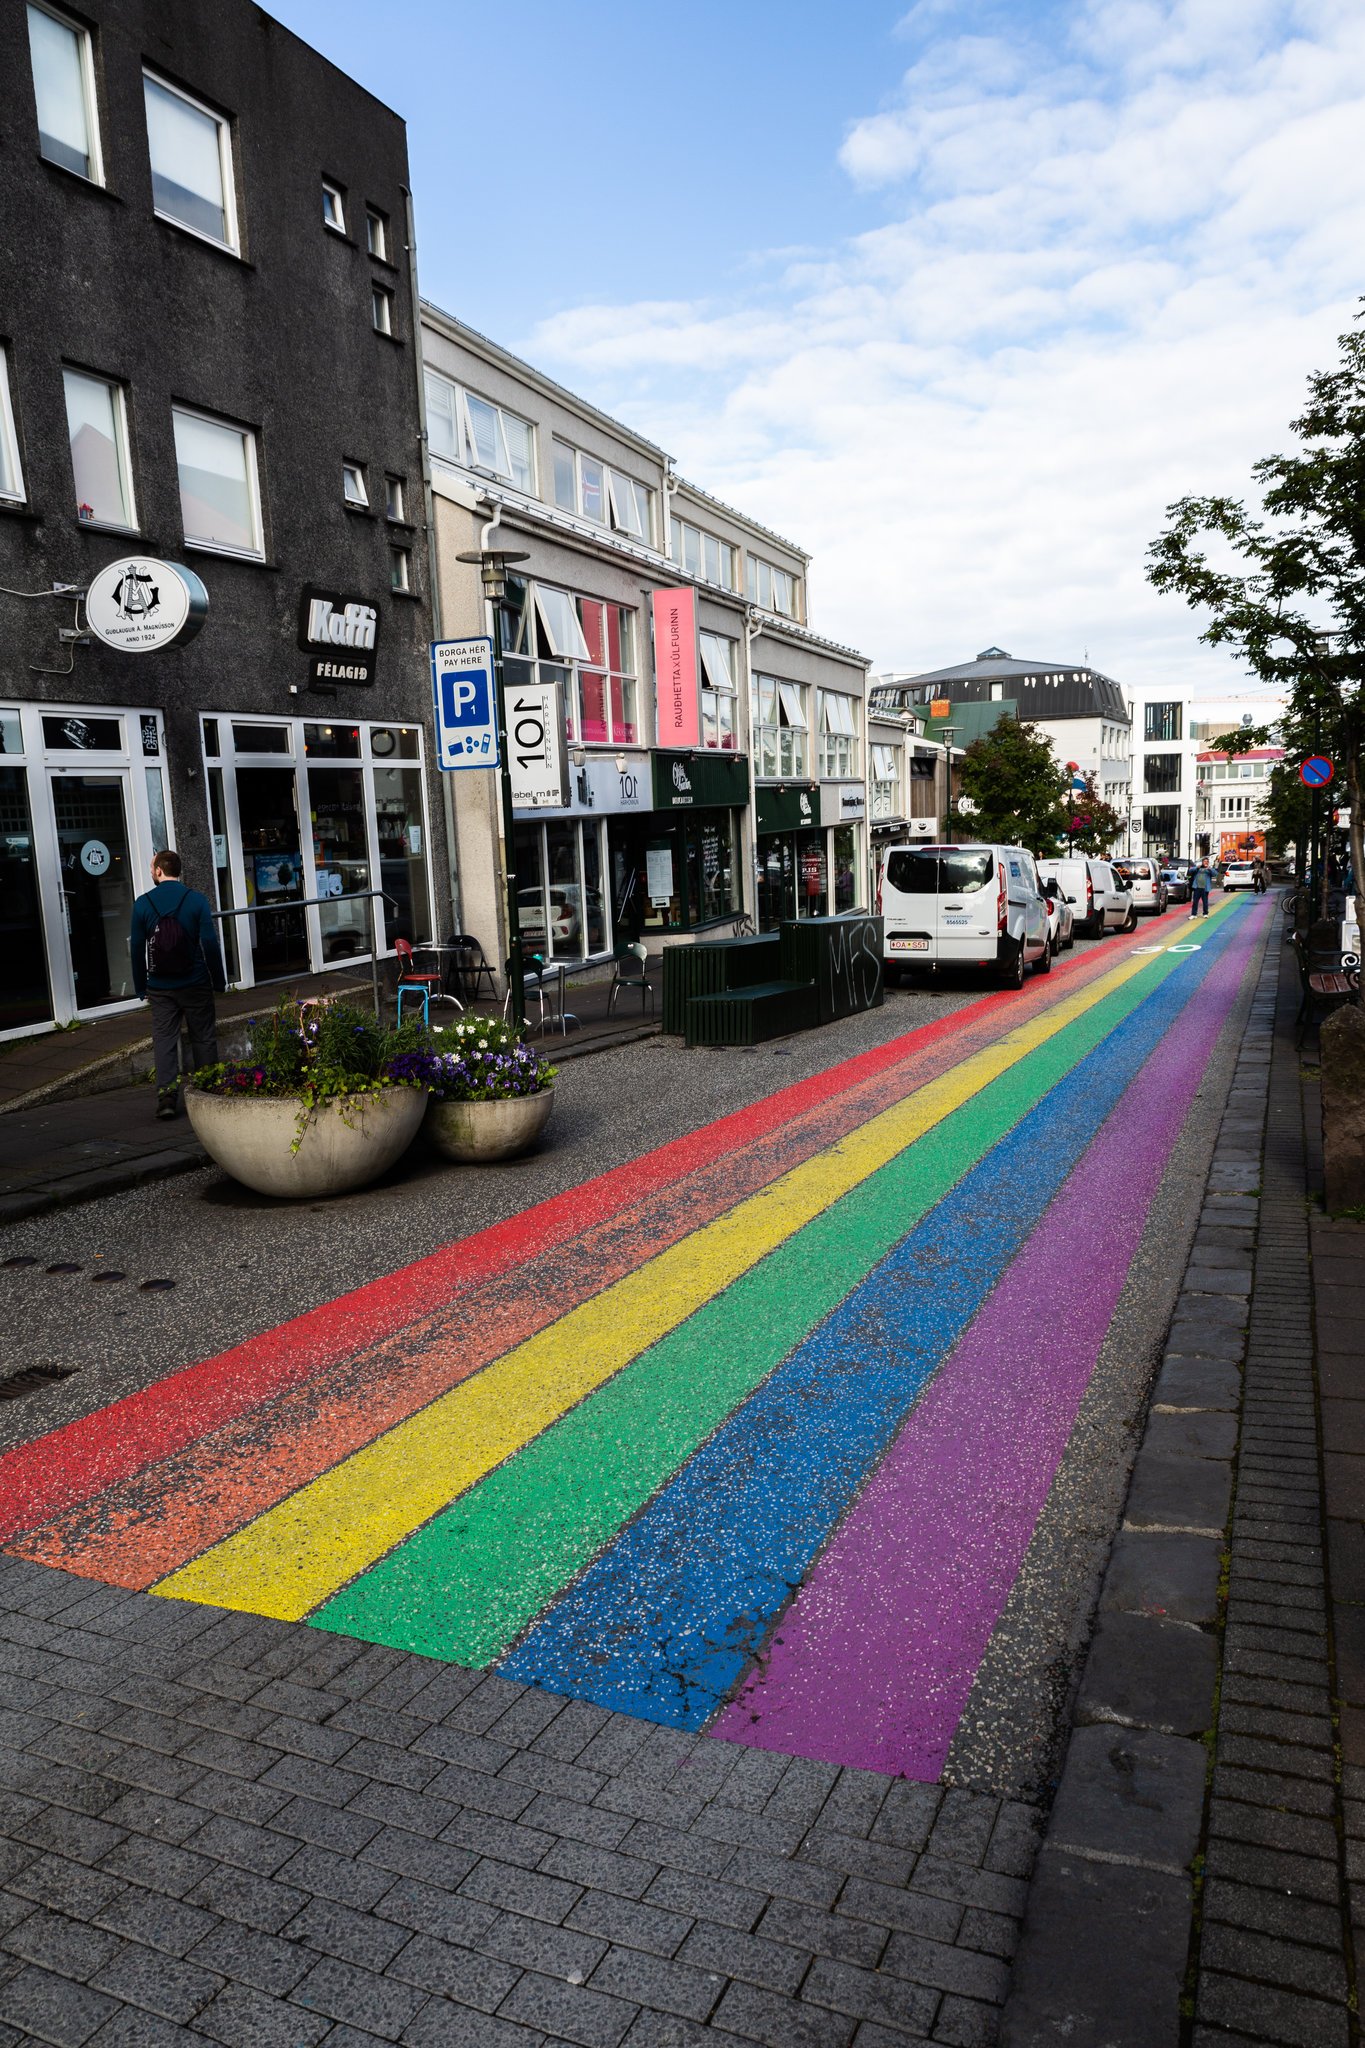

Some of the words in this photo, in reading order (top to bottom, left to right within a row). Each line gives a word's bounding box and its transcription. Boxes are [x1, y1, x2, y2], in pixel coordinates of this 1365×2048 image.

[308, 599, 377, 651] Kaffi
[439, 648, 467, 657] BORGA
[469, 645, 486, 654] HÉR
[444, 658, 458, 667] PAY
[461, 656, 482, 665] HERE
[453, 681, 477, 718] P
[619, 775, 638, 799] 101
[1130, 944, 1202, 955] 30
[828, 922, 881, 1014] MFS
